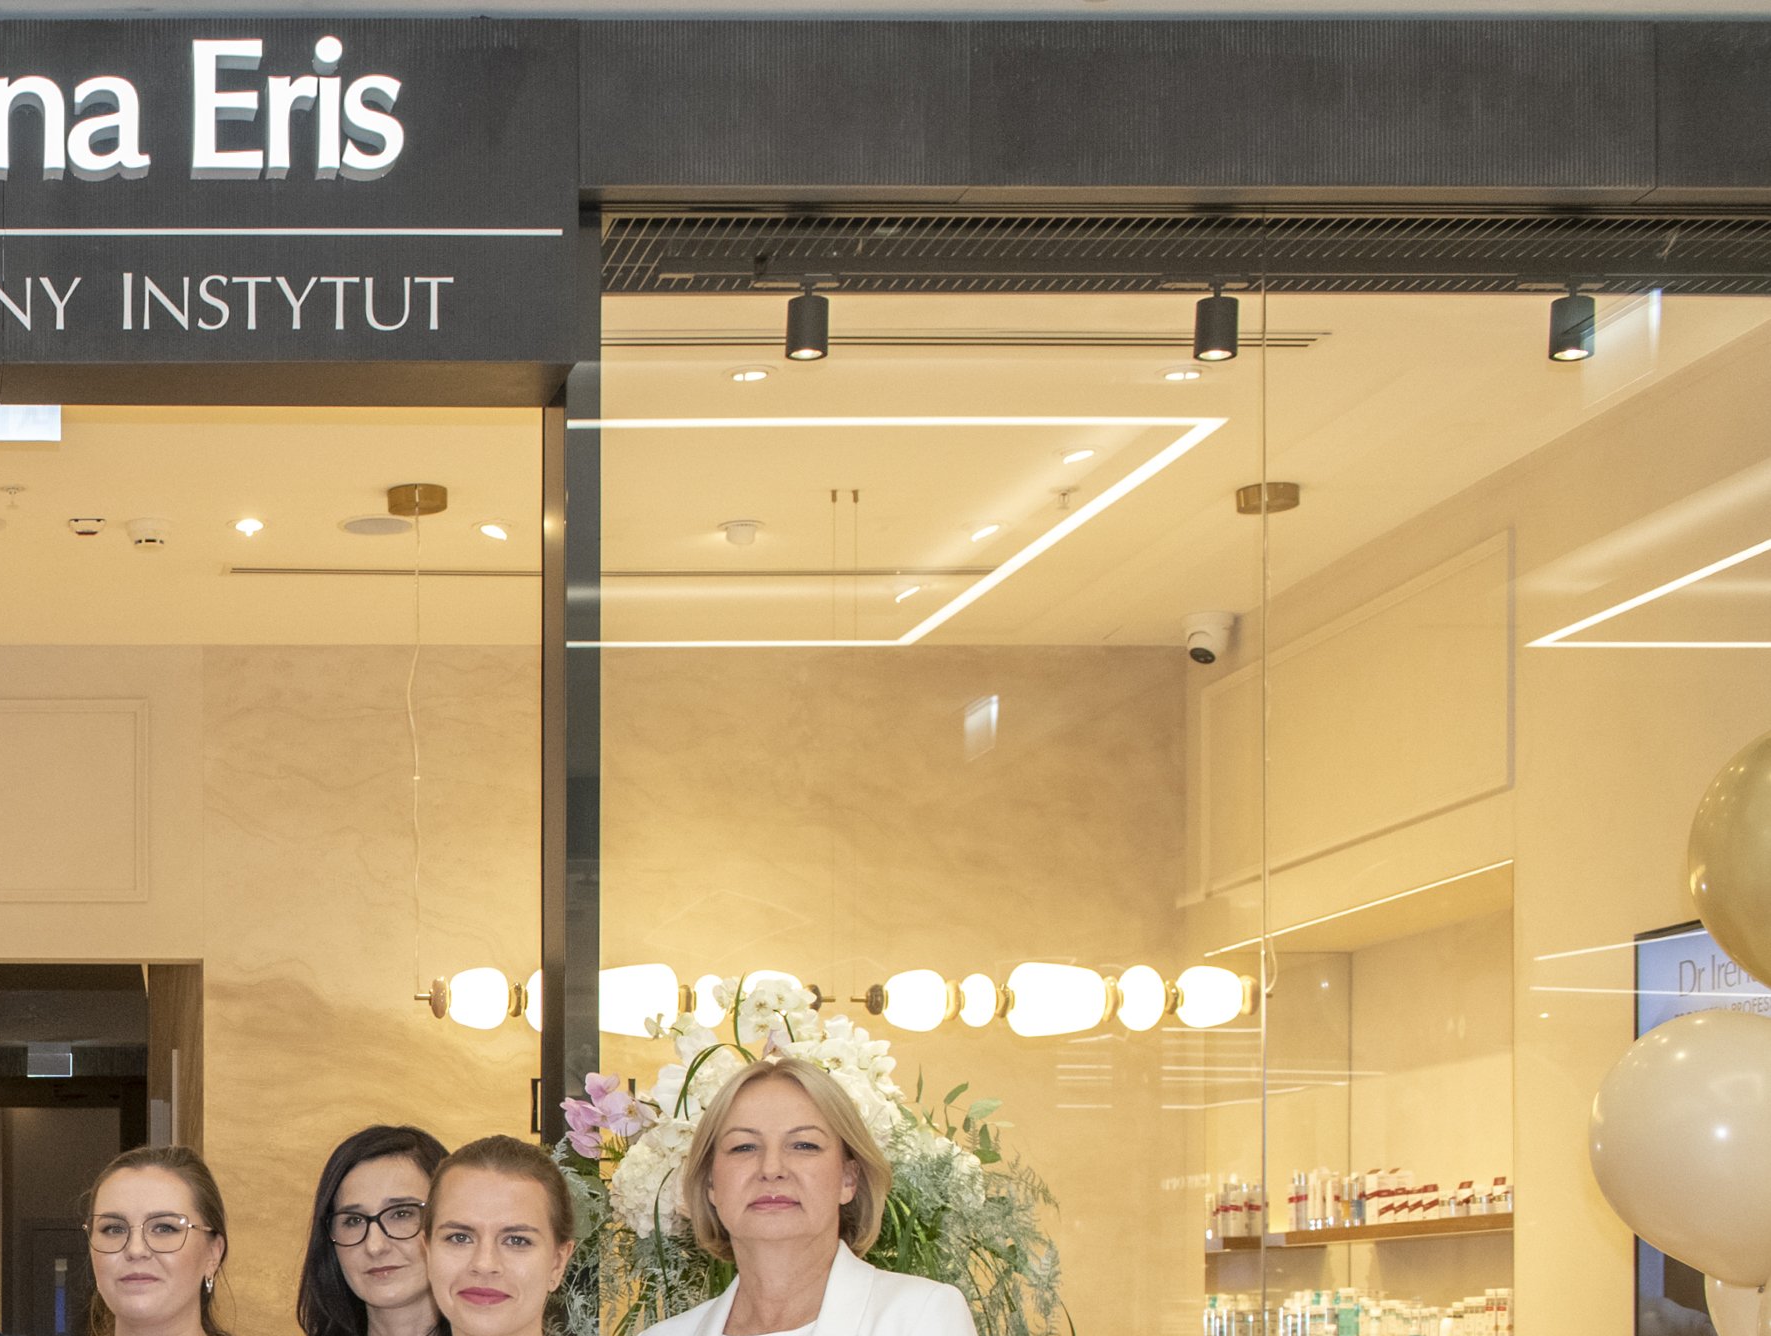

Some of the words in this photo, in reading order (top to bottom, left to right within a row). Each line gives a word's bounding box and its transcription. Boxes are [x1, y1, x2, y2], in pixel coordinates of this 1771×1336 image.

[191, 35, 405, 181] Eris
[122, 272, 455, 332] INSTYTUT
[1679, 959, 1705, 997] Dr
